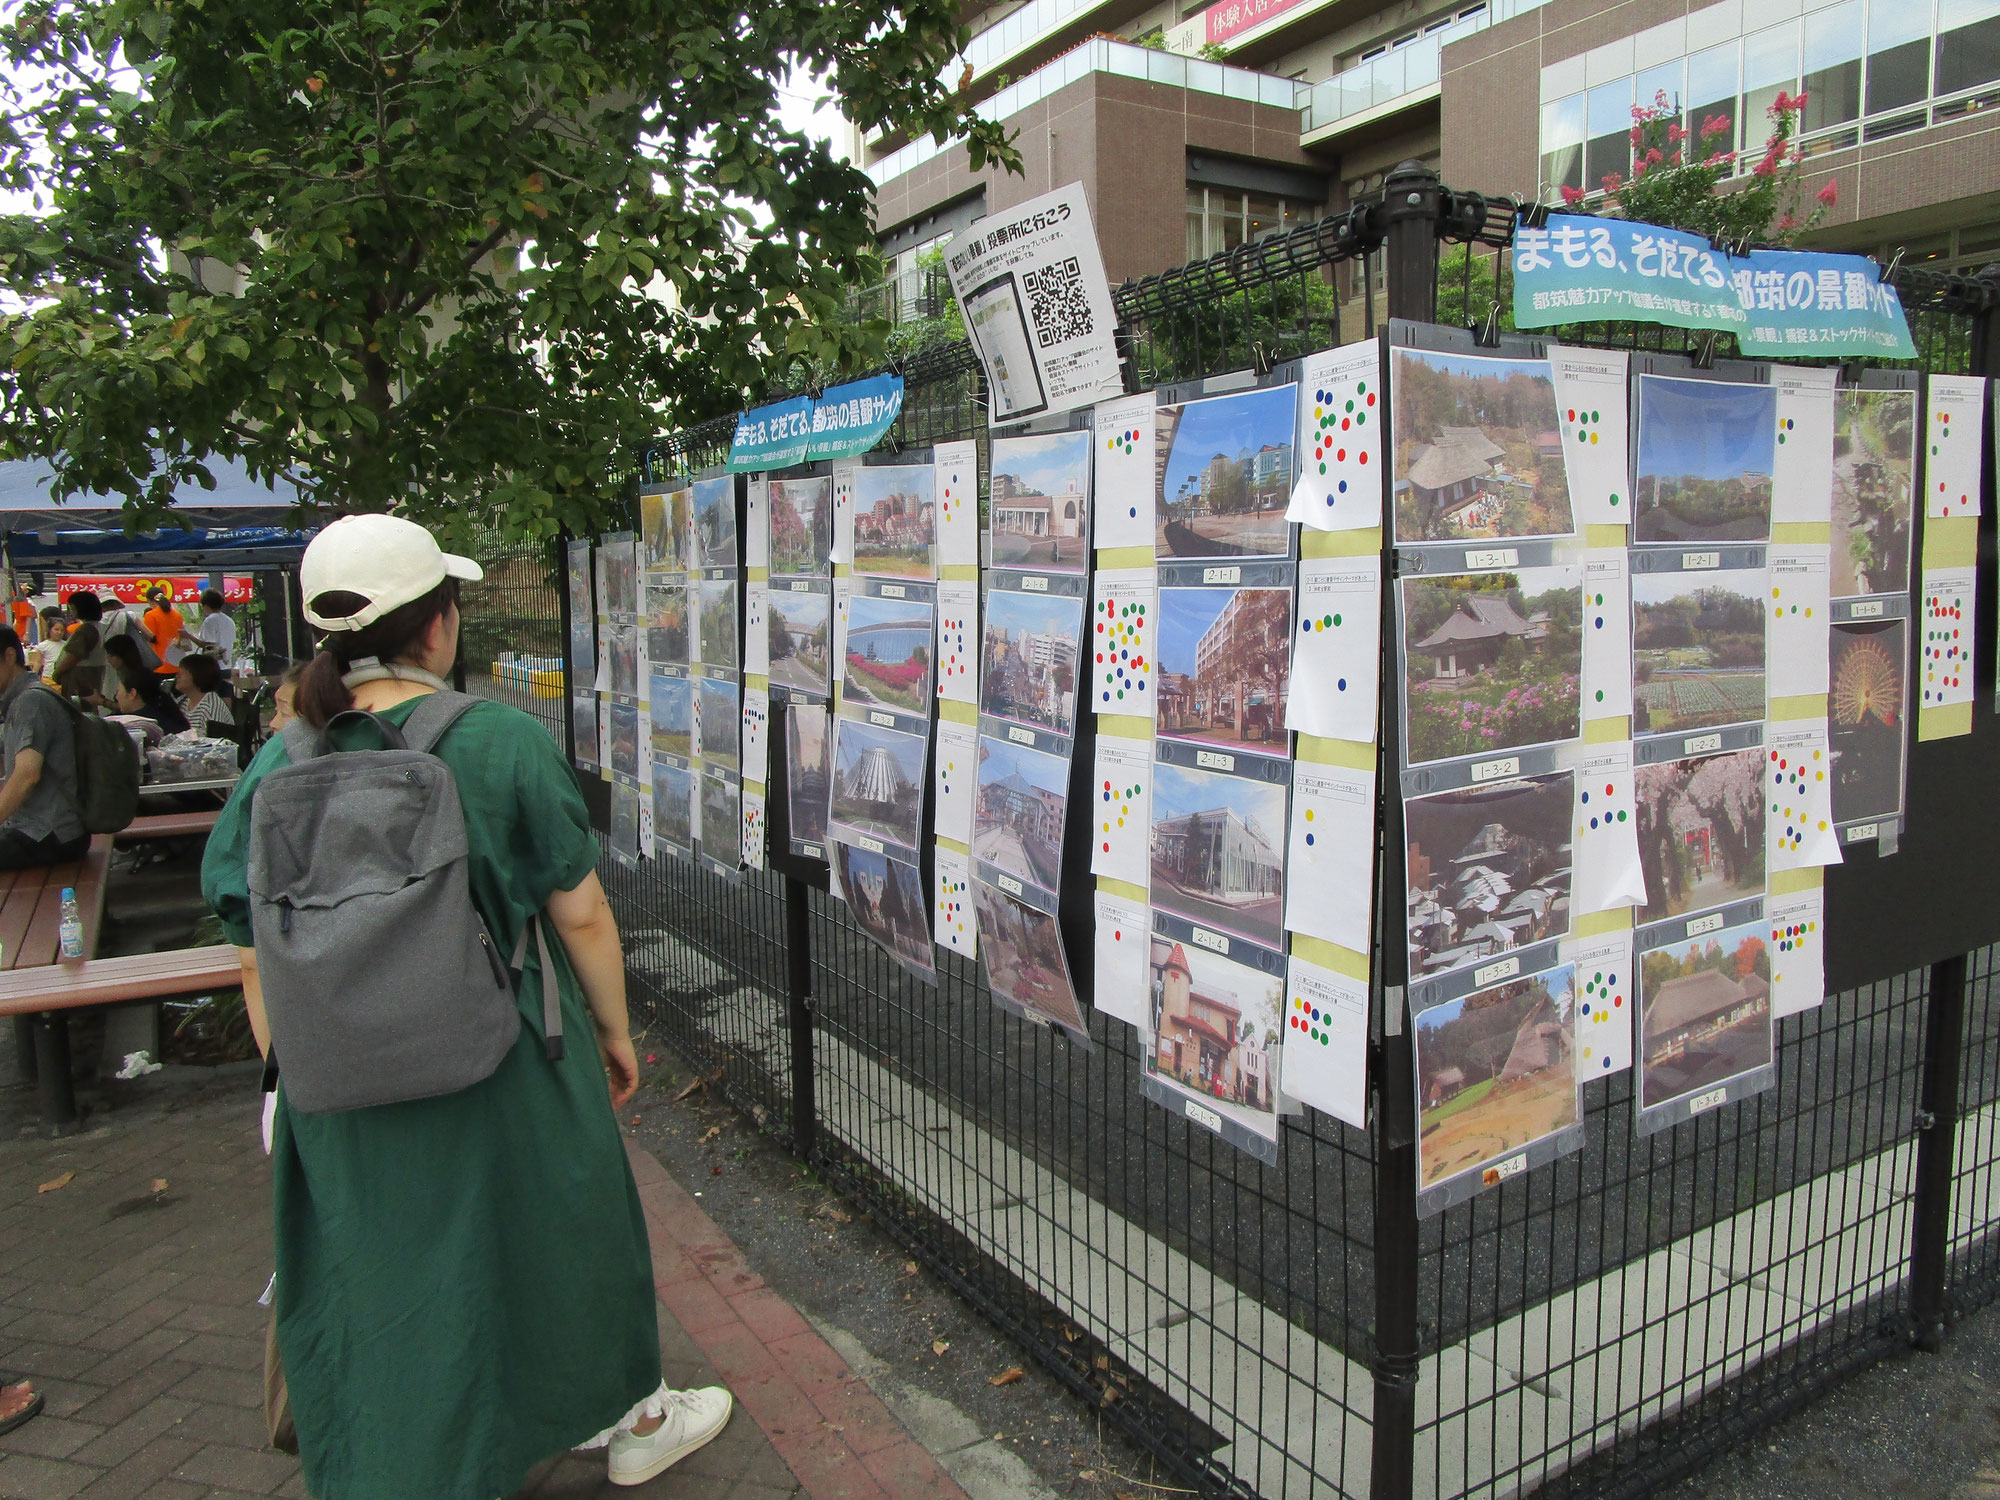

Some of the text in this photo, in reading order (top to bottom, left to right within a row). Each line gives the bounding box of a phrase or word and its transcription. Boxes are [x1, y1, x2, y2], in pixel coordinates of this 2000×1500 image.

[1516, 224, 1735, 291] まもる、そだてる、
[1474, 553, 1508, 566] 1-3-1
[1688, 555, 1711, 565] 1-2-1
[1208, 569, 1233, 581] 2-1-1
[1025, 580, 1044, 589] 2-1-6
[1855, 604, 1876, 615] 1-1-6
[1690, 736, 1715, 749] 1-2-2
[1201, 753, 1228, 767] 2-1-3
[1481, 761, 1512, 776] 1-3-2
[1851, 827, 1874, 840] 2-1-2
[1001, 876, 1019, 892] 2-2-2
[1691, 921, 1715, 932] 1-3-5
[1197, 933, 1224, 951] 2-1-4
[1482, 962, 1511, 981] 1-3-3
[1694, 1091, 1721, 1110] 1-3-6
[1189, 1106, 1216, 1126] 2-1-5
